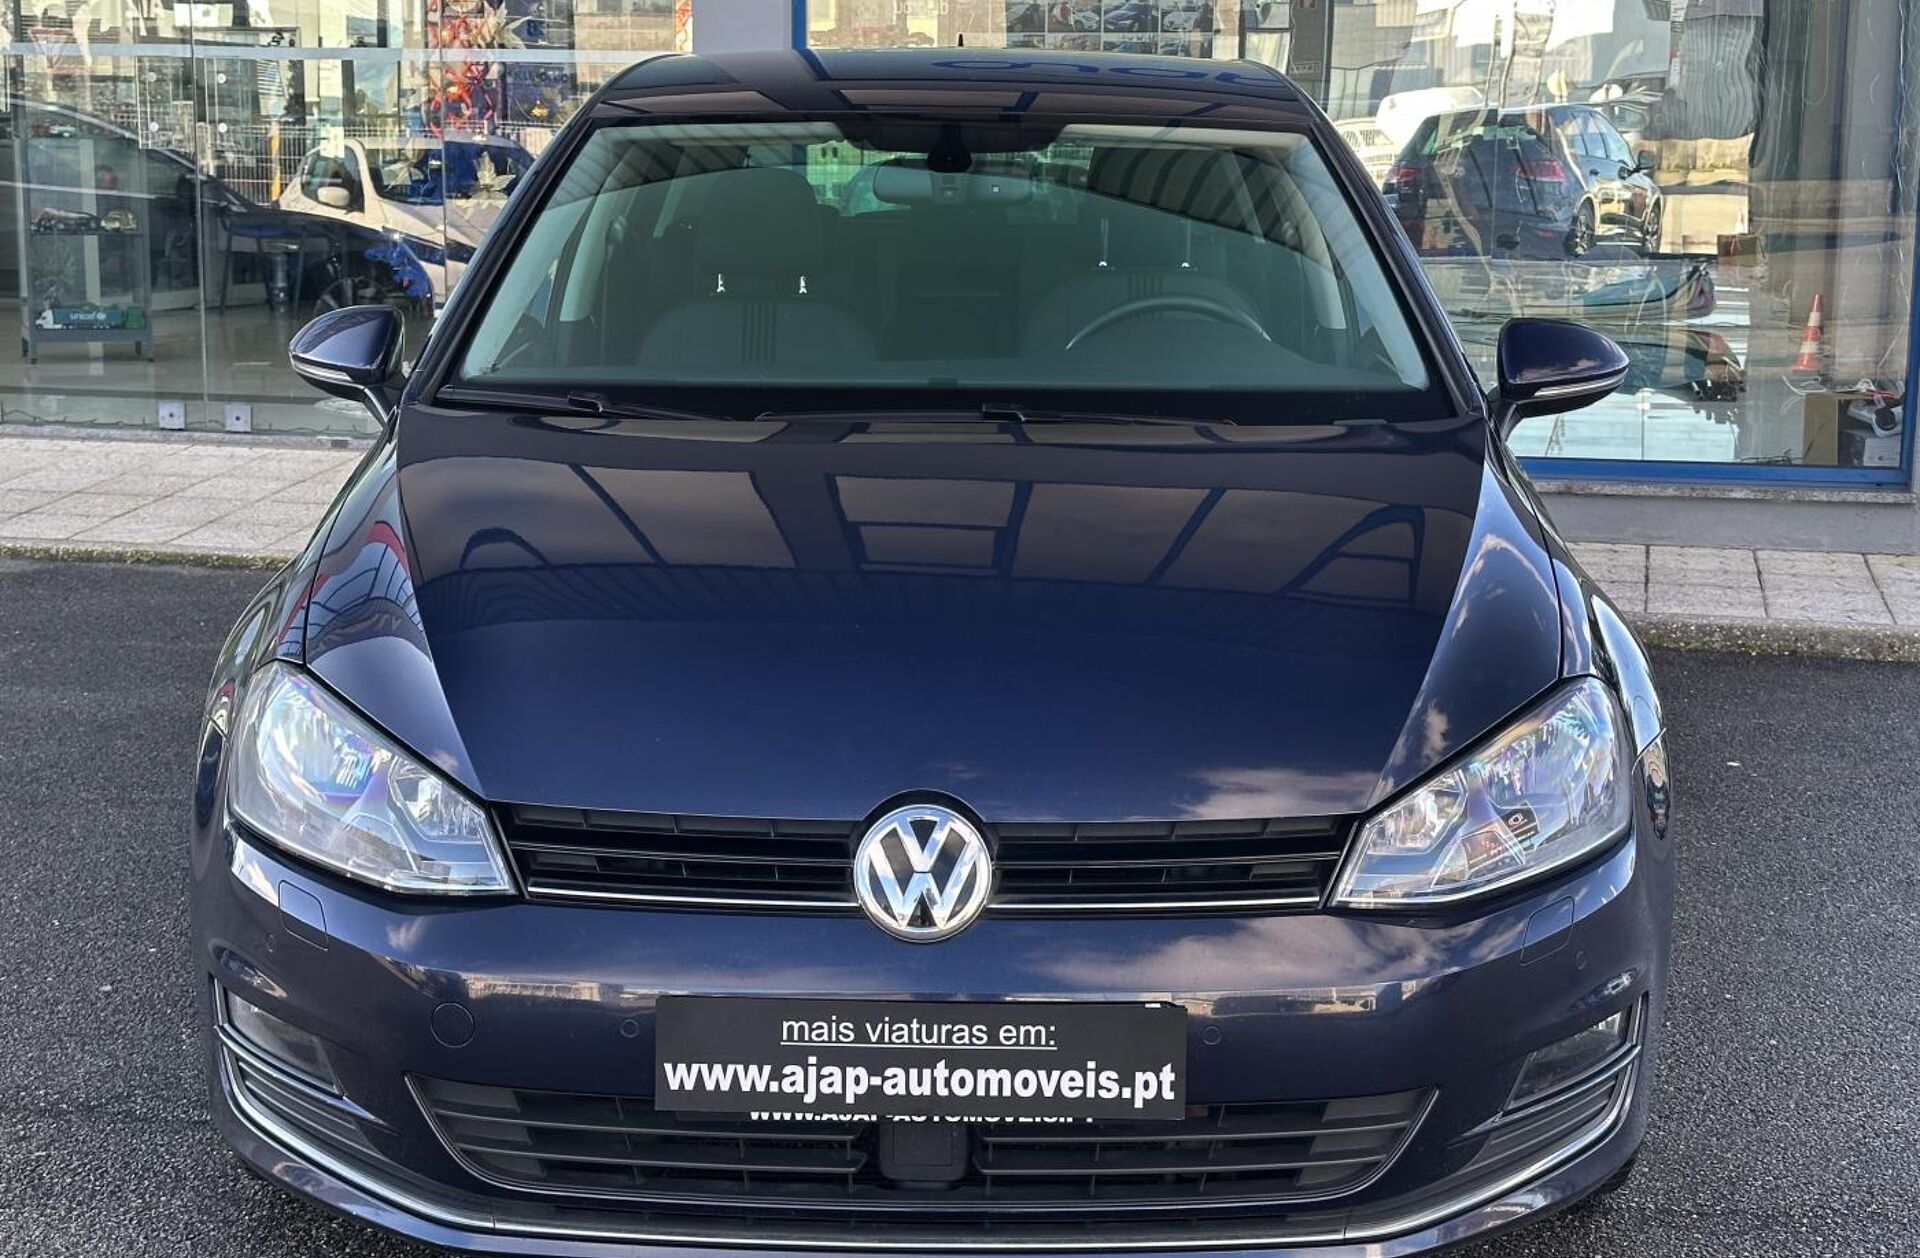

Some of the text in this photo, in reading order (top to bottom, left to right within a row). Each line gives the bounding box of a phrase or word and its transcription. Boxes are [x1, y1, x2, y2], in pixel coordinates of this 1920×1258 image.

[781, 1015, 1057, 1046] mais viaturas em:
[663, 1055, 1176, 1109] www.ajap-automoveis.pt
